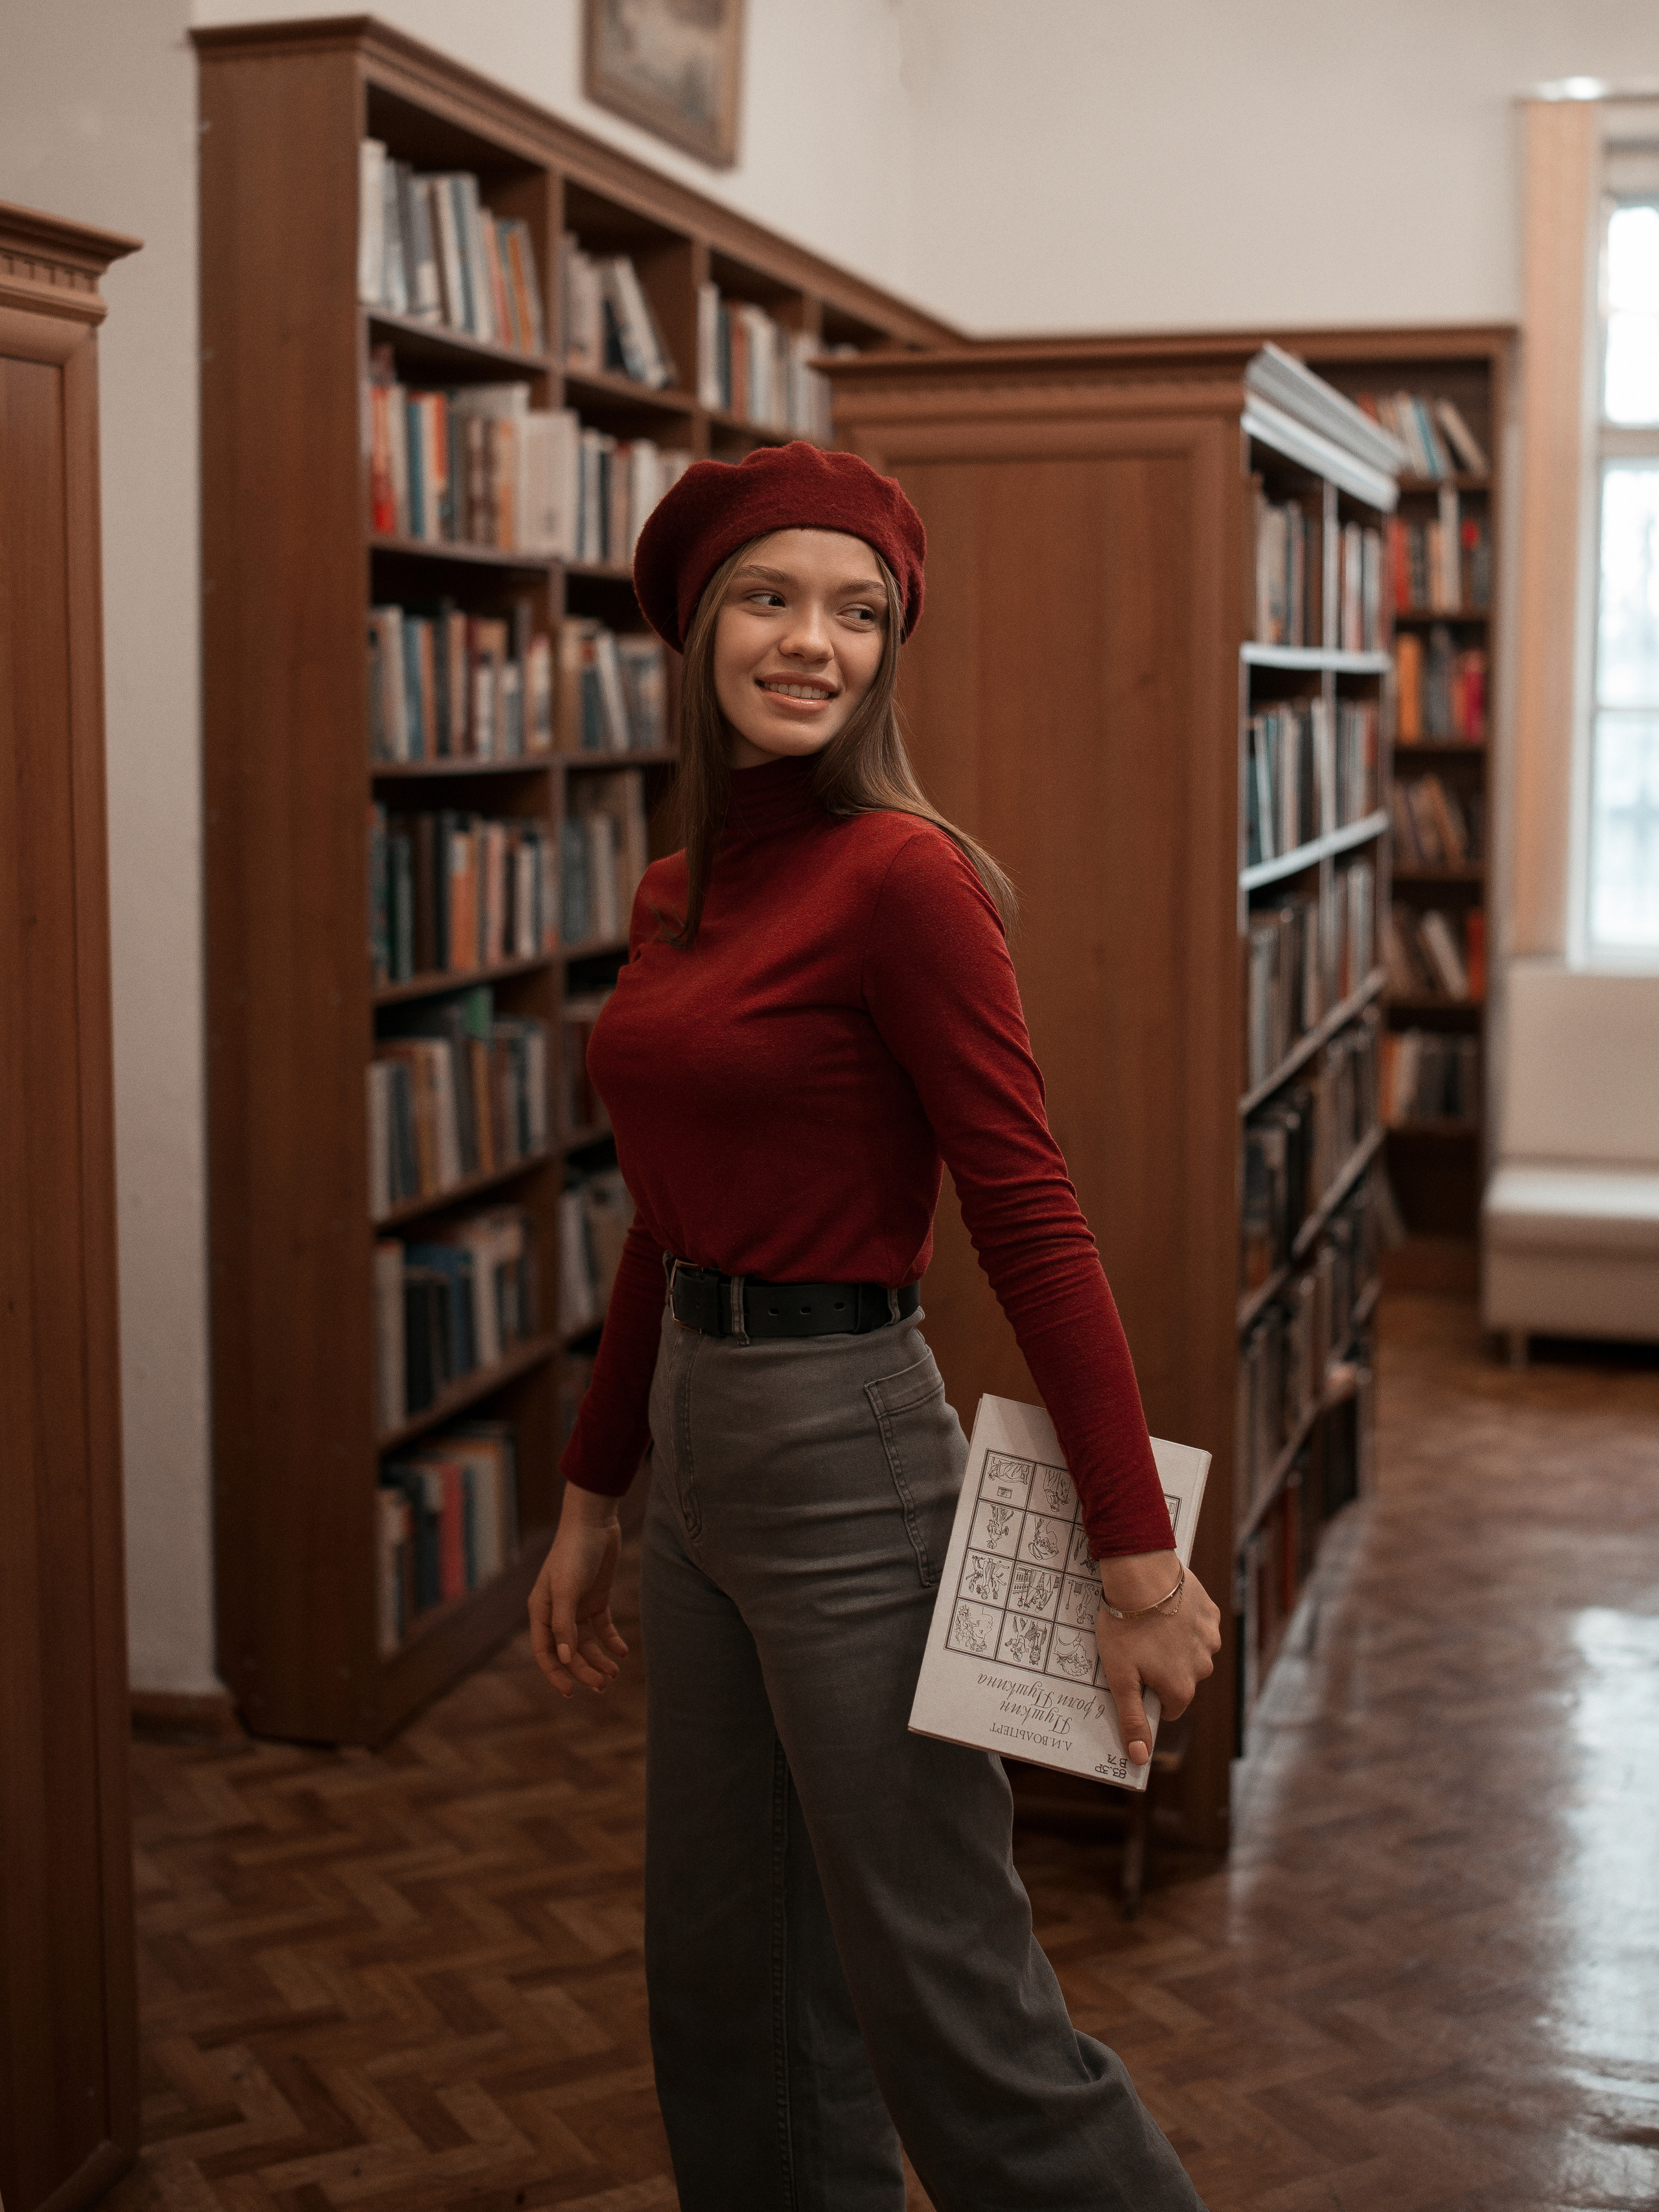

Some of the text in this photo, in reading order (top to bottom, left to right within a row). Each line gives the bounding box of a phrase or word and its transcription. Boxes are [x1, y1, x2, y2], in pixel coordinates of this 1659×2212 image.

[977, 1673, 1106, 1719] в роли Пушкина
[999, 1700, 1073, 1735] Пушкин
[1107, 1753, 1117, 1765] 71
